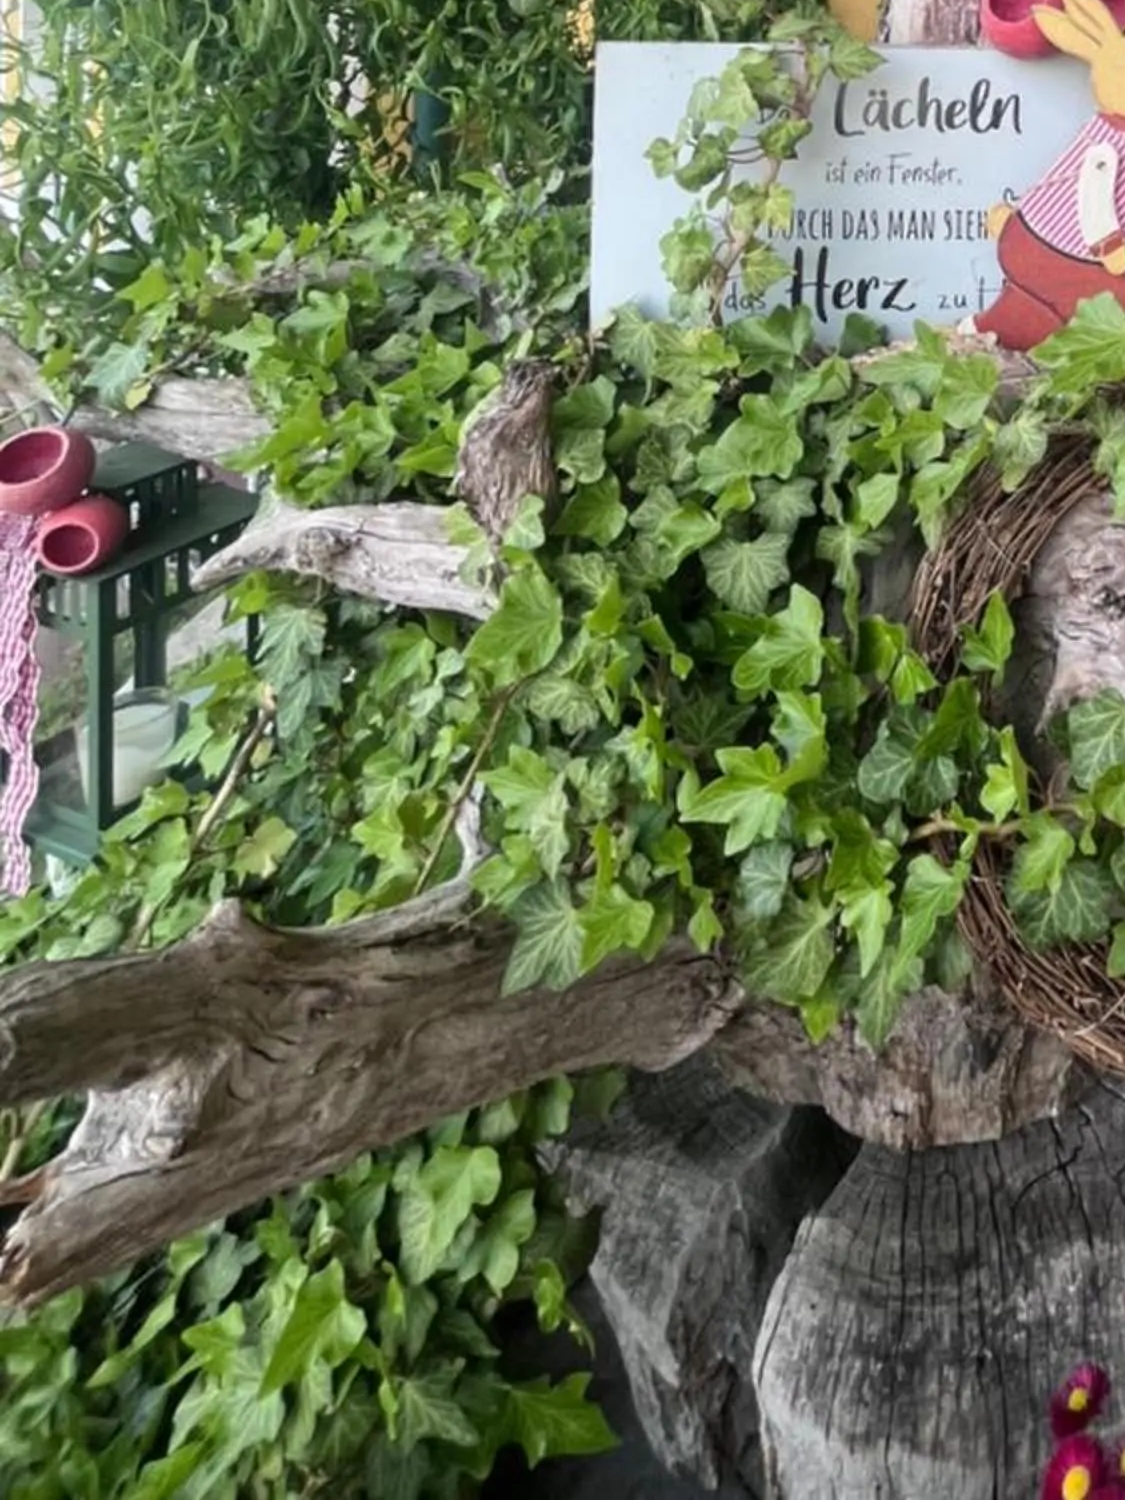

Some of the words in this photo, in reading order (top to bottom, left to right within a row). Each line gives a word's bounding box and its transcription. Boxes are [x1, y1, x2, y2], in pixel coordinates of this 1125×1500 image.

[833, 77, 1023, 137] Lächeln
[825, 155, 848, 184] ist
[853, 160, 882, 183] ein
[841, 208, 879, 241] DAS
[887, 209, 936, 241] MAN
[943, 208, 988, 241] SIEH
[724, 282, 766, 310] das
[785, 245, 917, 325] Herz
[937, 294, 967, 310] zu
